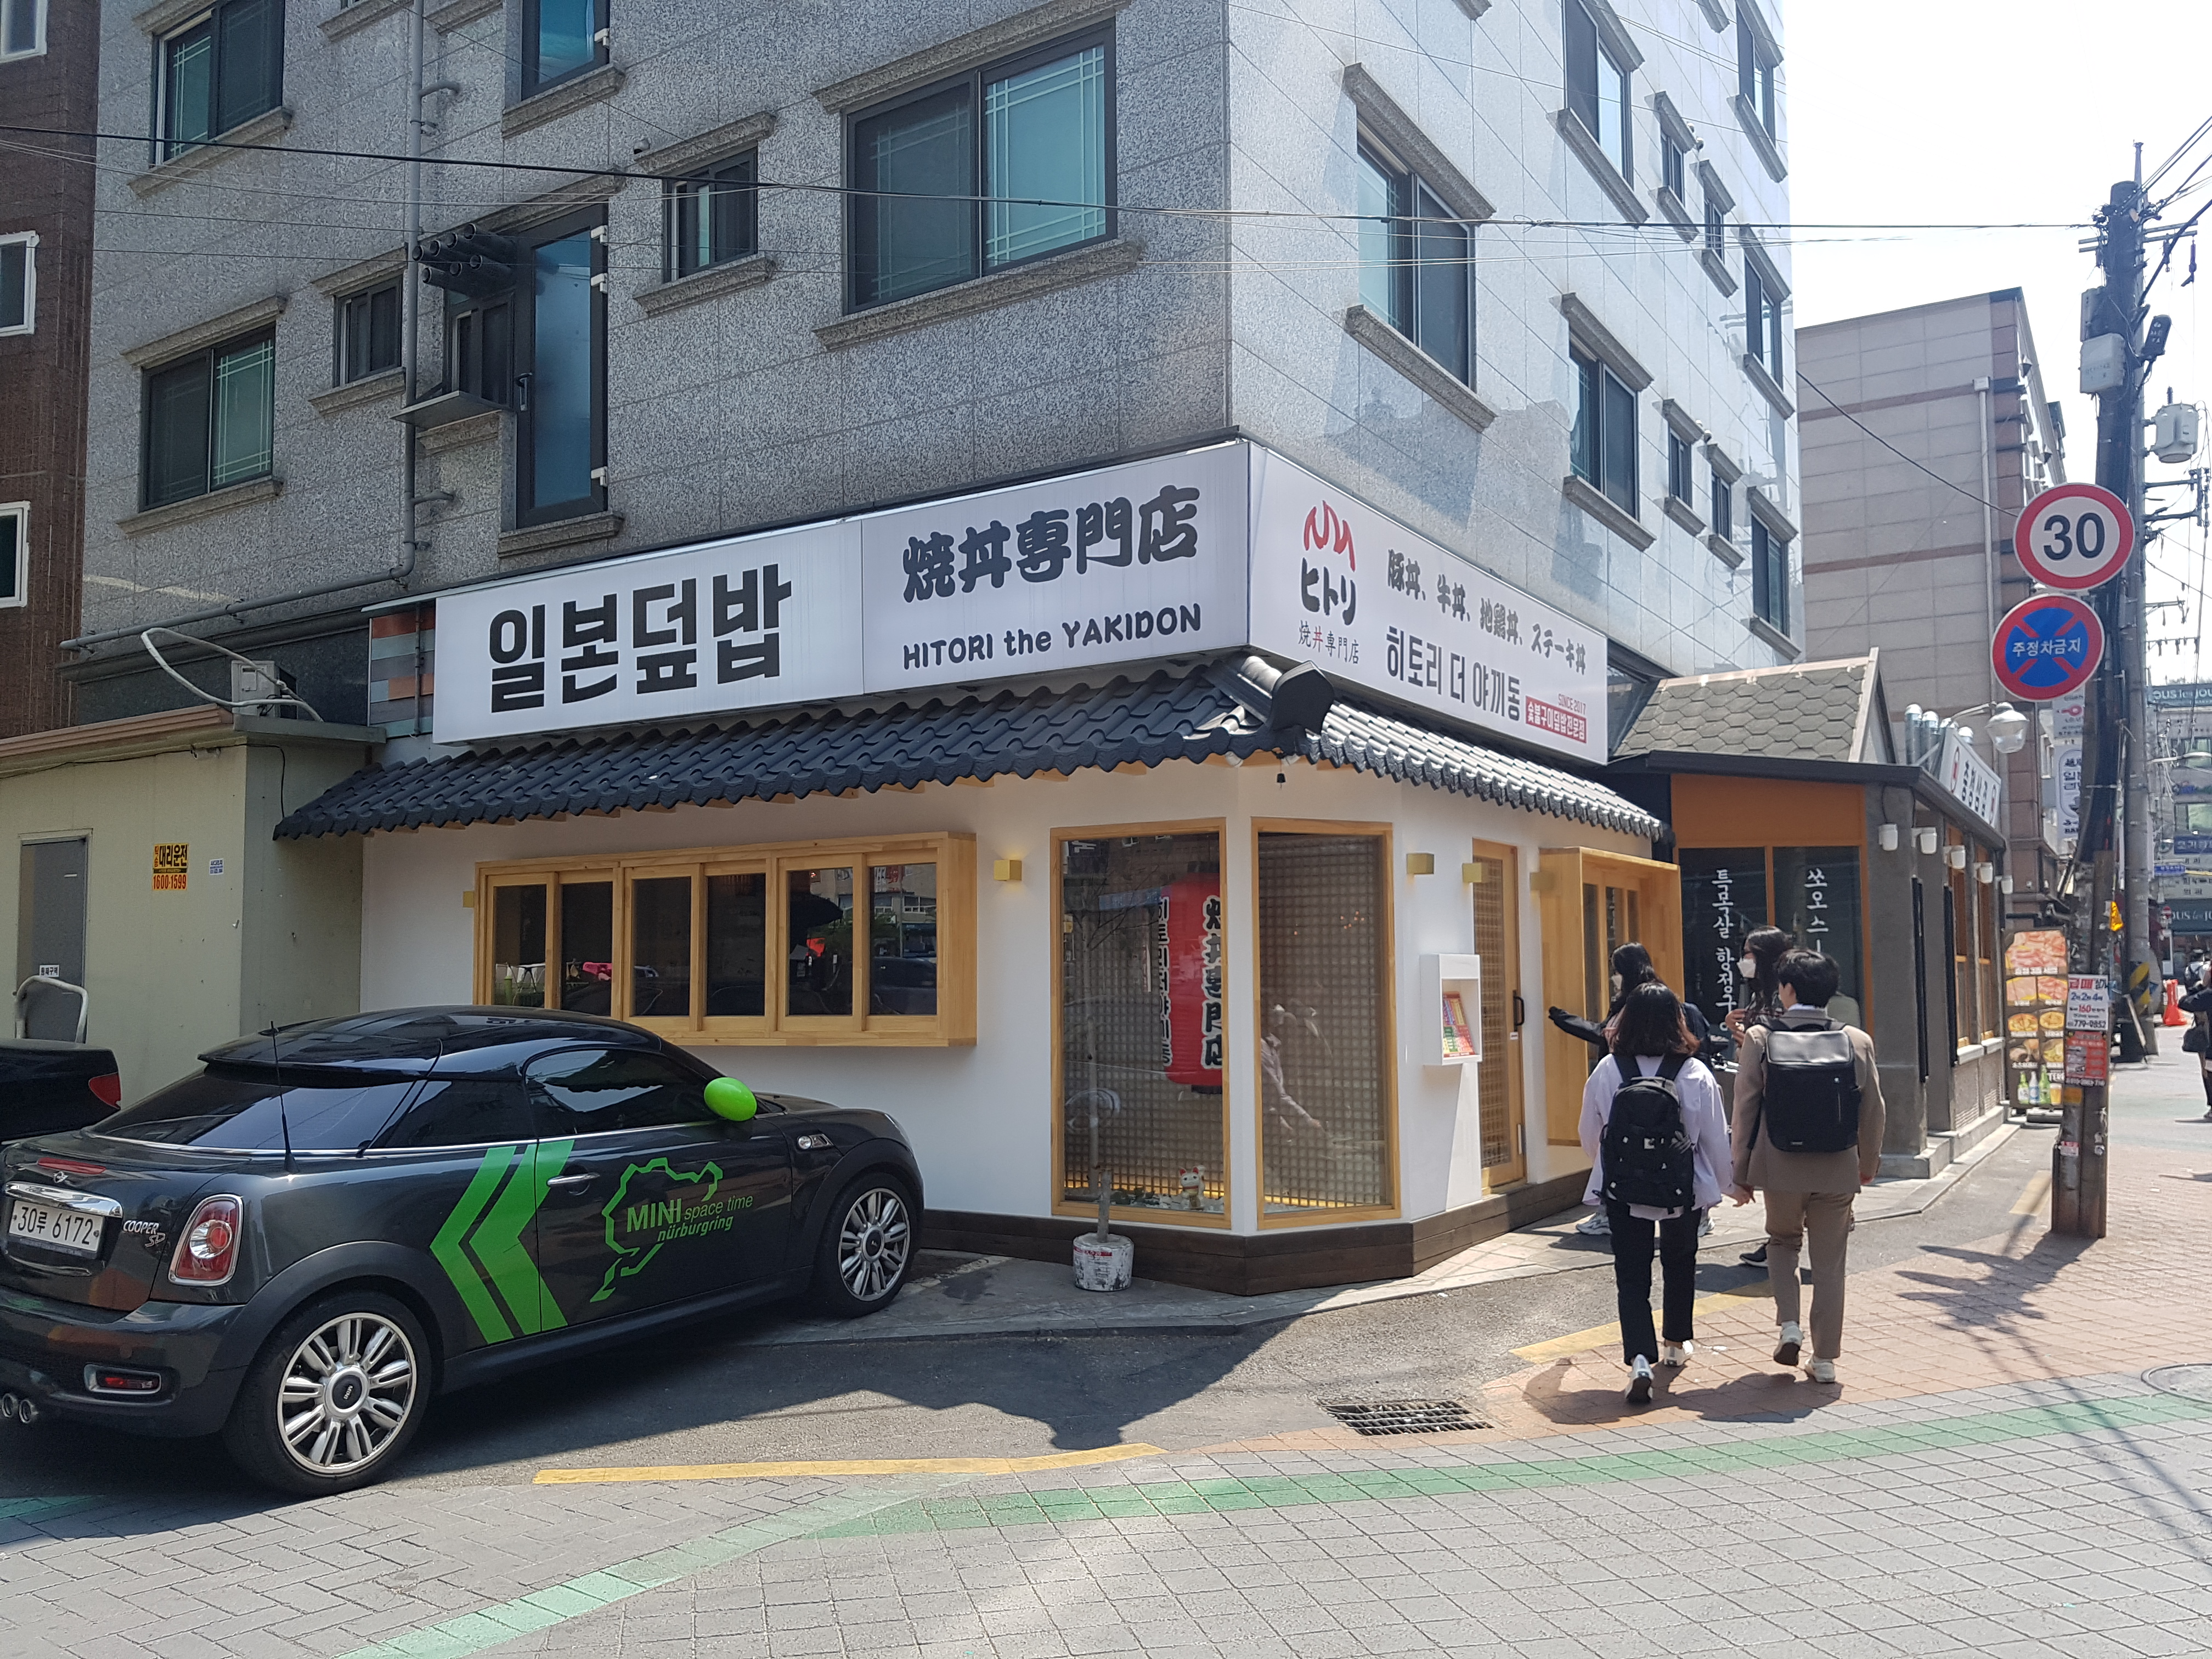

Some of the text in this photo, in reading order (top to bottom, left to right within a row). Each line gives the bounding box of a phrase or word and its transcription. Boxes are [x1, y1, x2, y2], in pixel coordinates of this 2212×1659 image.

[903, 485, 1200, 603] 焼丼専門店
[2043, 512, 2106, 561] 30
[1301, 557, 1356, 625] ヒトリ
[489, 564, 792, 713] 일본덮밥
[904, 603, 1201, 670] HITORI the YAKIDON
[2012, 637, 2081, 657] 주정차금지
[1386, 625, 1521, 721] 히토리 더 야끼동
[1527, 701, 1585, 740] 숯불구이덮밥전문점
[159, 844, 188, 867] 대리운전
[18, 1206, 93, 1245] 30루 6172
[123, 1220, 160, 1234] COOPER
[627, 1195, 753, 1233] MINI space time
[658, 1215, 733, 1242] nürburgring
[144, 1232, 166, 1247] SD
[343, 1385, 353, 1400] MINI
